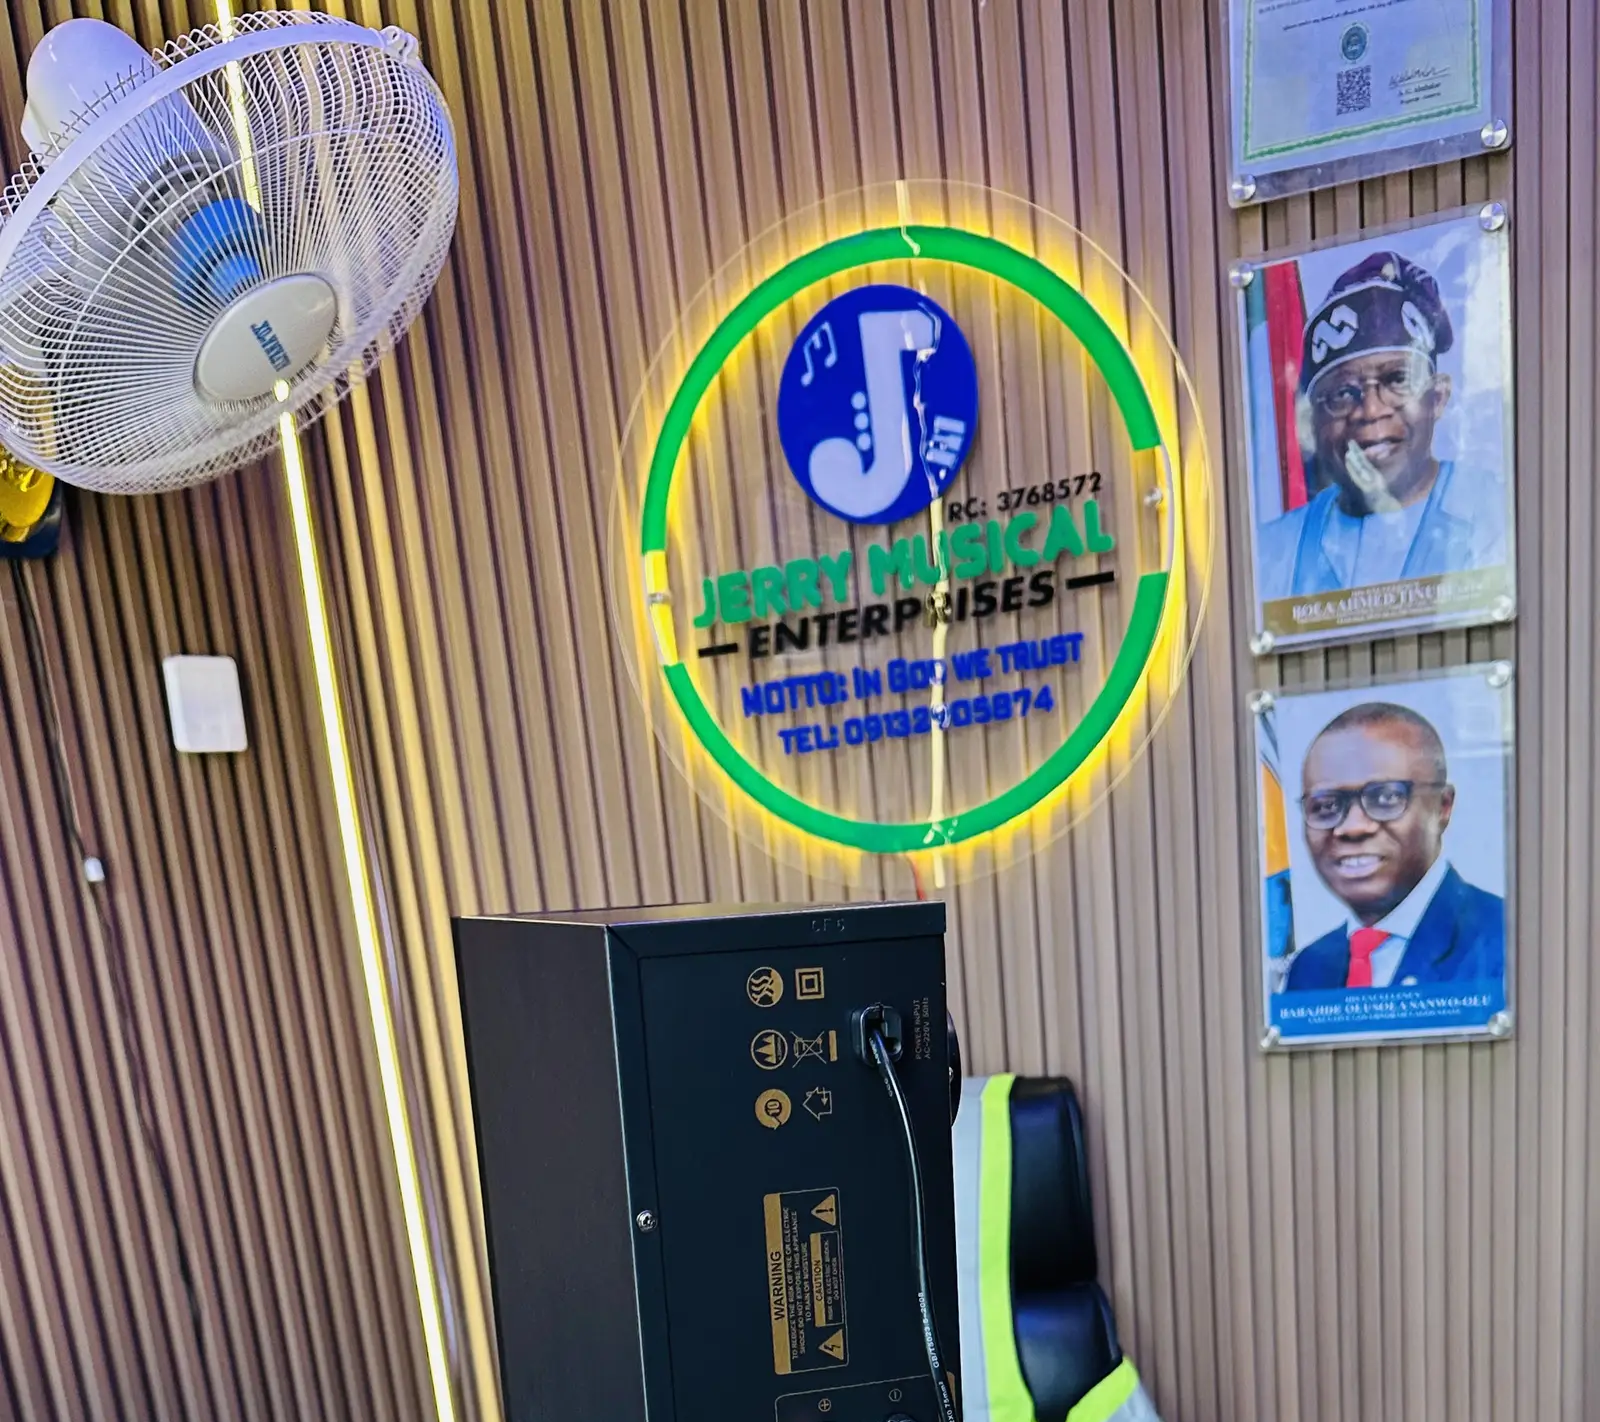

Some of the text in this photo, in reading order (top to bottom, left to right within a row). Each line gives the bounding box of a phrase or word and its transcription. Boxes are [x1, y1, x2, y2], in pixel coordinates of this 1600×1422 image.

[948, 471, 1102, 523] RC: 3768572
[693, 499, 1115, 630] JERRY MUSICAL
[740, 670, 849, 718] MOTTO:
[951, 647, 993, 682] WE
[995, 631, 1085, 674] TRUST
[777, 723, 840, 755] TEL:
[912, 999, 923, 1060] POWER INPUT
[790, 1210, 799, 1251] APPLIANCE
[769, 1251, 786, 1321] WARNING
[787, 1285, 795, 1302] RISK
[812, 1259, 823, 1302] CAUTION
[805, 1311, 812, 1321] TO
[792, 1349, 799, 1359] TO
